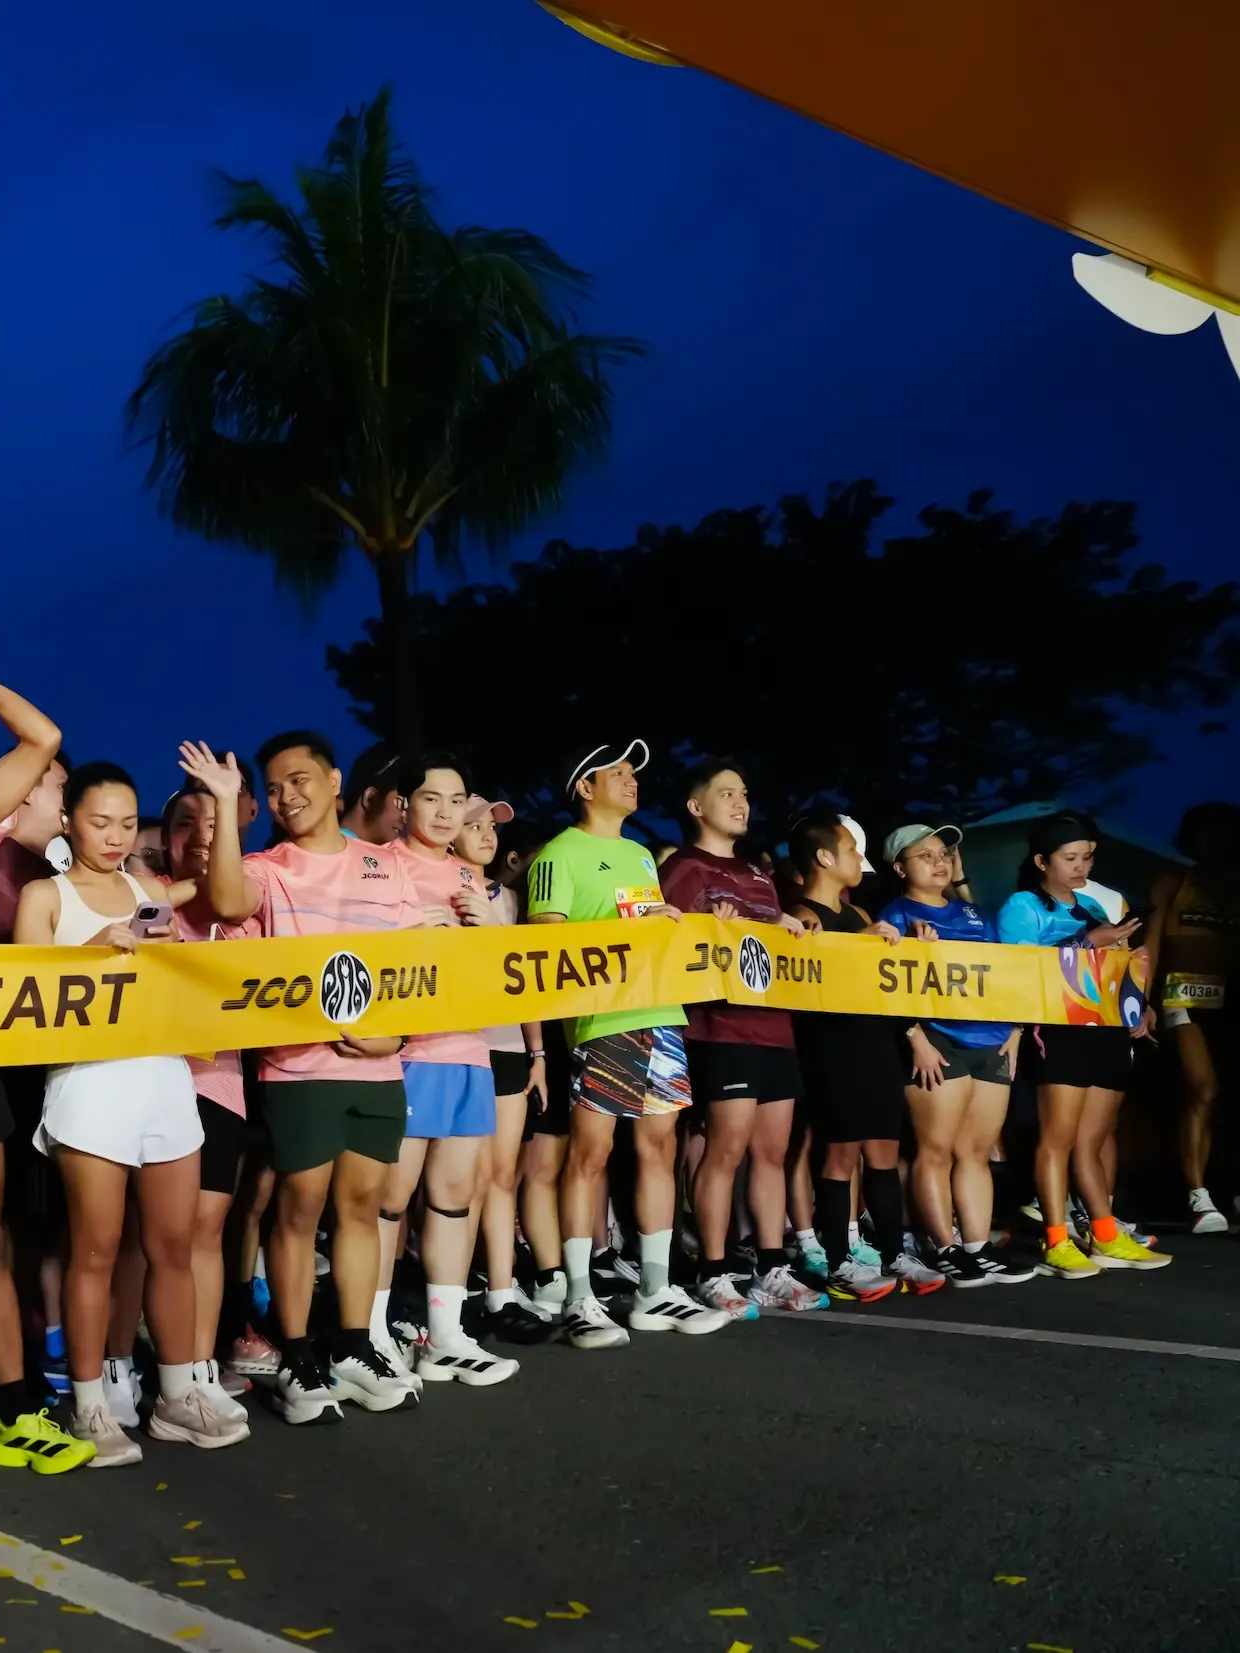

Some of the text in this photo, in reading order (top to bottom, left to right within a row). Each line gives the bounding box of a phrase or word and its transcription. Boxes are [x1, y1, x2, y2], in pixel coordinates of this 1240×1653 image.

[221, 965, 437, 1011] JCO RUN
[503, 943, 632, 996] START
[776, 955, 822, 984] RUN
[878, 958, 991, 998] START
